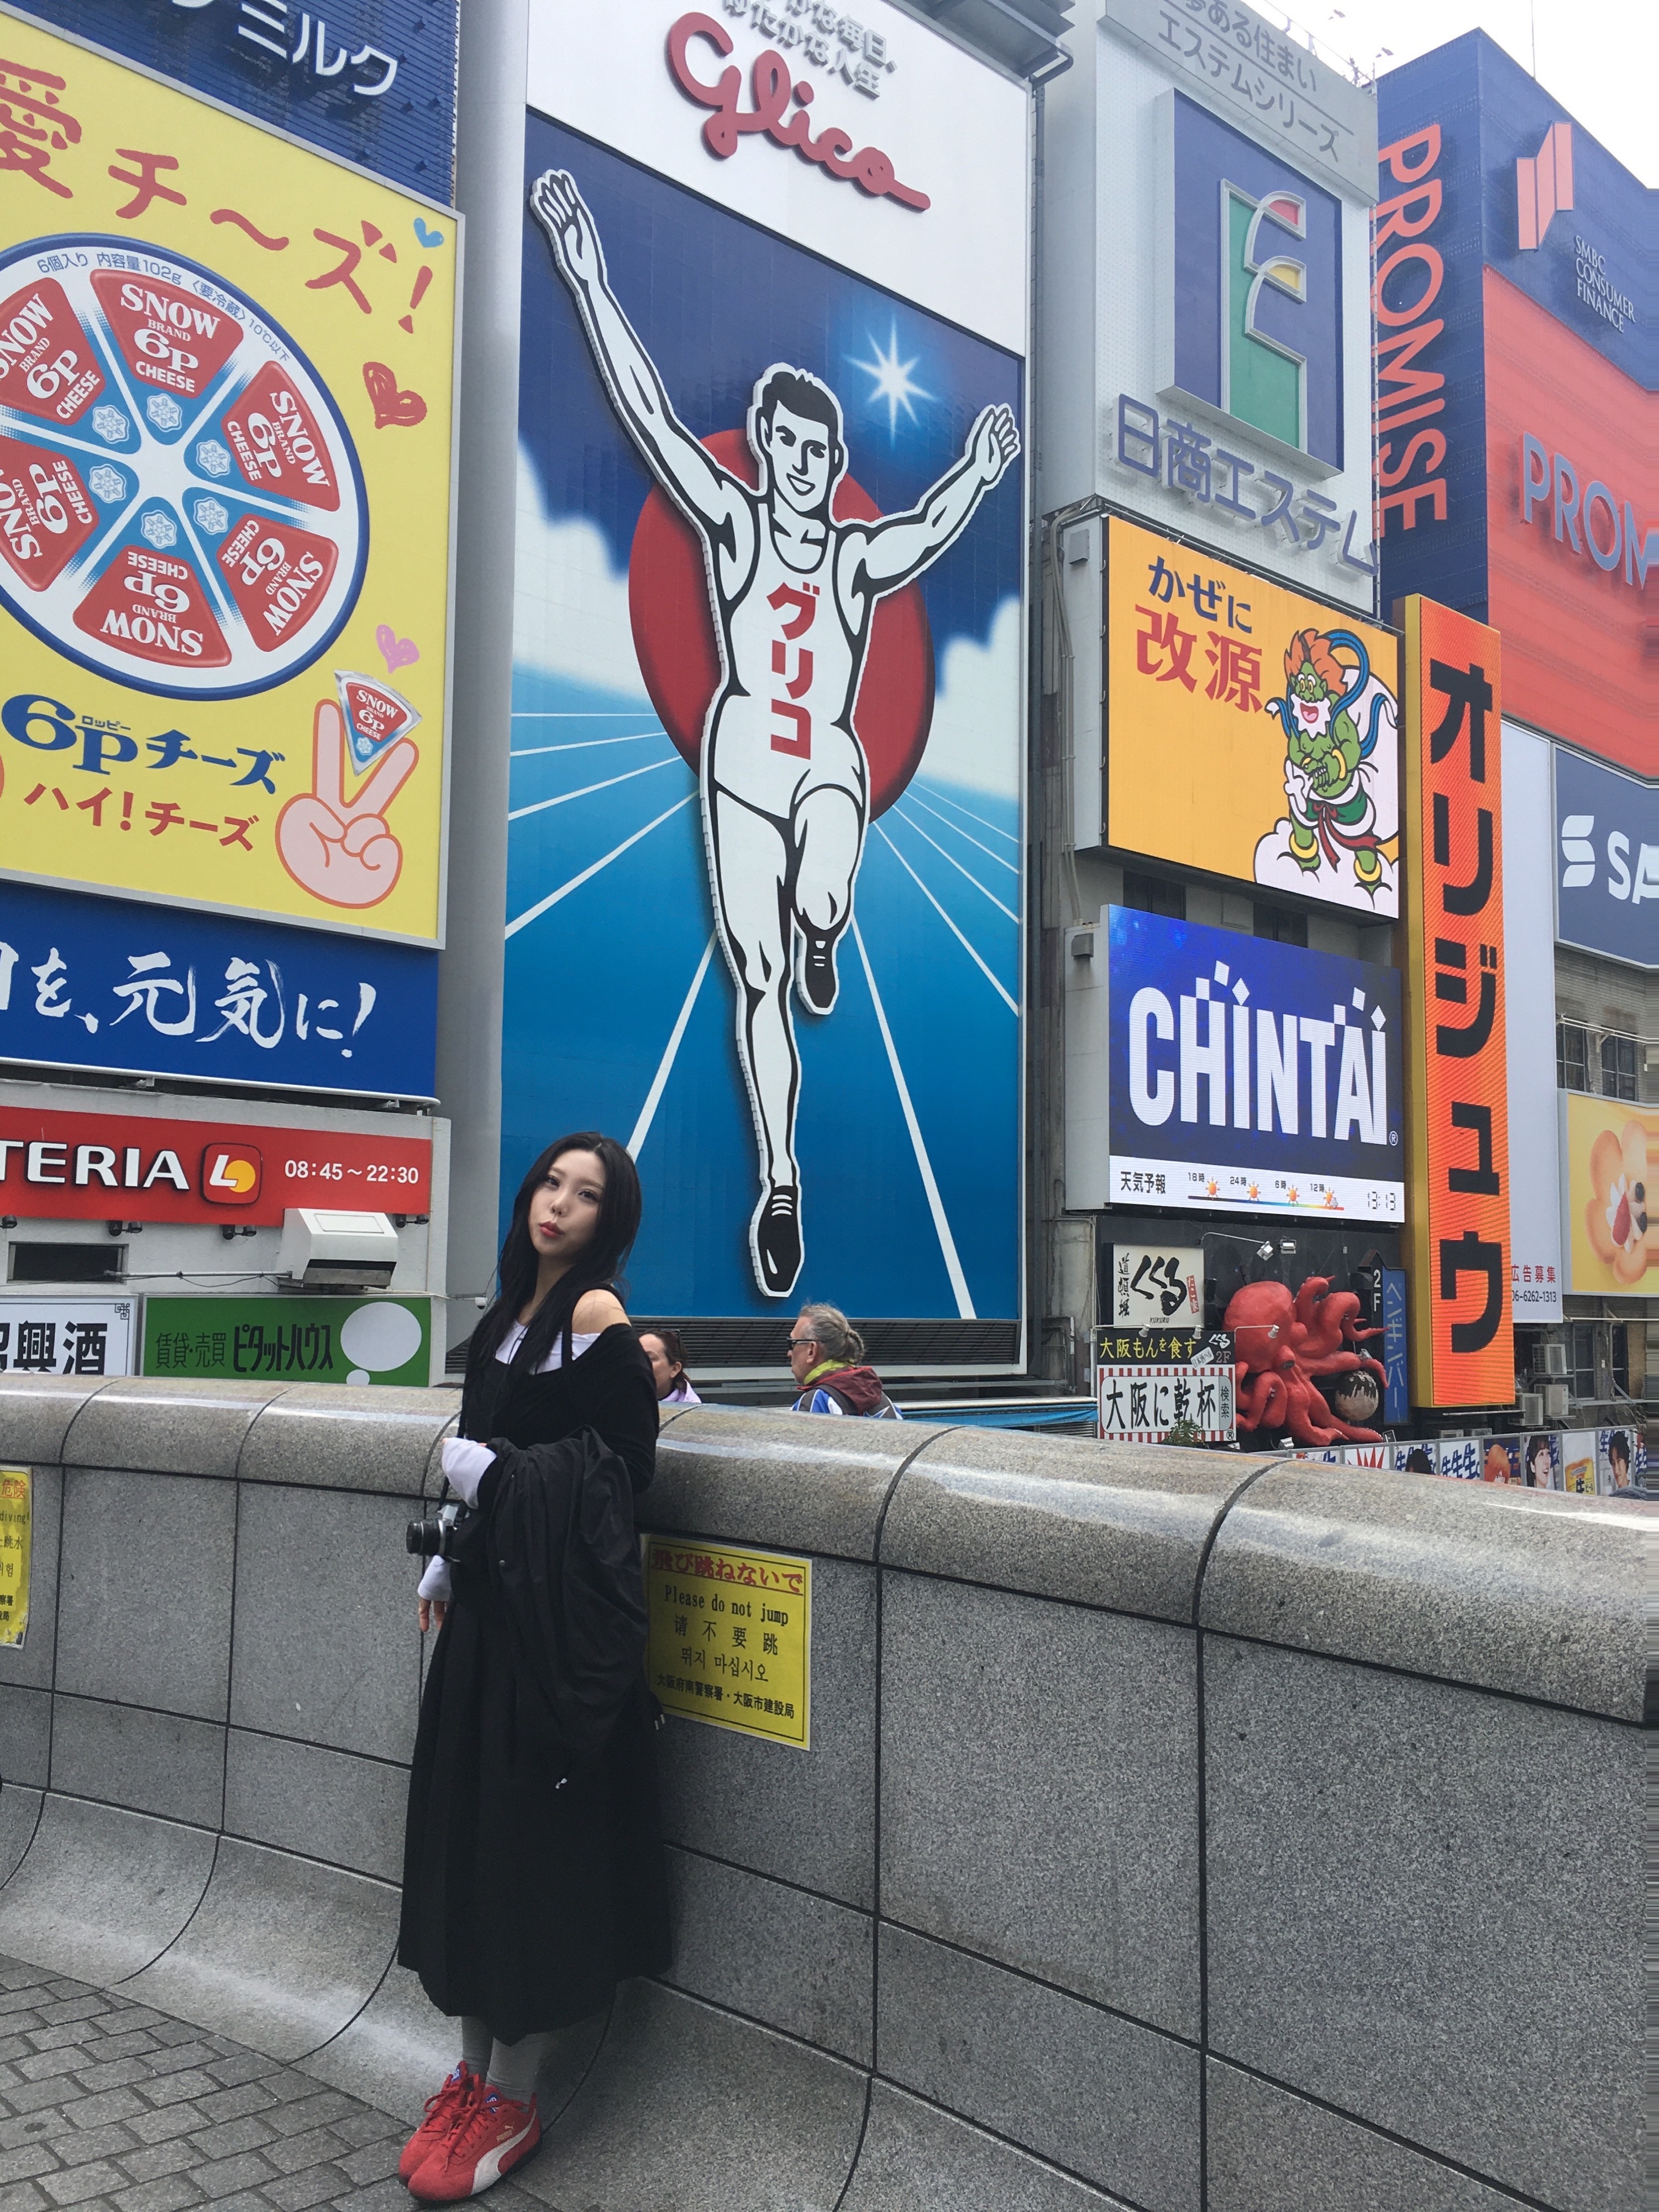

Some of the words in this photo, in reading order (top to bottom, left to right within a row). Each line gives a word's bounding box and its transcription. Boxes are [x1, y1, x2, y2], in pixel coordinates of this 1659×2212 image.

[172, 0, 398, 96] ミルク
[1158, 9, 1339, 163] エステムシリーズ
[666, 11, 932, 212] Glico
[38, 251, 88, 273] 6個入り
[1576, 235, 1607, 276] SMBC
[120, 283, 221, 339] SNOW
[1576, 258, 1636, 323] CONSUMER
[1577, 277, 1624, 333] FINANCE
[134, 328, 199, 374] 6P
[147, 319, 191, 342] BRAND
[1369, 123, 1447, 540] PROMISE
[18, 337, 50, 373] BRAND
[27, 349, 80, 399] 6P
[135, 360, 196, 394] CHEESE
[56, 370, 101, 419] CHEESE
[227, 421, 262, 481] CHEESE
[248, 412, 282, 478] 6P
[269, 391, 330, 487] SNOW
[272, 421, 296, 464] BRAND
[12, 478, 41, 526] BRAND
[29, 463, 68, 534] 6P
[52, 460, 93, 524] CHEESE
[1117, 392, 1380, 578] 日商エステム
[127, 551, 188, 580] CHEESE
[221, 520, 260, 569] CHEESE
[241, 538, 285, 585] 6P
[123, 570, 190, 613] 6P
[262, 551, 324, 637] SNOW
[265, 560, 292, 596] BRAND
[1148, 555, 1252, 635] かぜに
[99, 609, 204, 657] SNOW
[132, 604, 177, 623] BRAND
[766, 580, 821, 761] グリコ
[1135, 604, 1264, 714] 改源
[81, 715, 132, 731] ロッピー
[356, 689, 398, 719] SNOW
[358, 709, 385, 731] 6P
[356, 723, 381, 741] CHEESE
[1120, 1171, 1167, 1194] 天気予報
[1188, 1172, 1205, 1183] 18時
[1230, 1176, 1247, 1187] 24時
[1274, 1180, 1287, 1190] 6時
[1310, 1183, 1326, 1193] 12時
[1117, 1252, 1131, 1318] 道頓堀
[1130, 1255, 1188, 1317] くくる
[1511, 1264, 1556, 1283] 広告募集
[233, 1324, 334, 1372] ピタットハウス
[1099, 1336, 1197, 1360] 大阪もんを食す
[1216, 1351, 1232, 1364] 2F
[1106, 1377, 1216, 1430] 大阪に乾杯
[1220, 1385, 1230, 1419] 検索
[653, 1549, 803, 1593] 飛び跳ねないで
[665, 1584, 705, 1609] Please
[711, 1594, 725, 1612] do
[732, 1602, 752, 1618] not
[760, 1603, 789, 1627] jump
[680, 1646, 706, 1670] 뛰지
[713, 1653, 769, 1682] 마십시오
